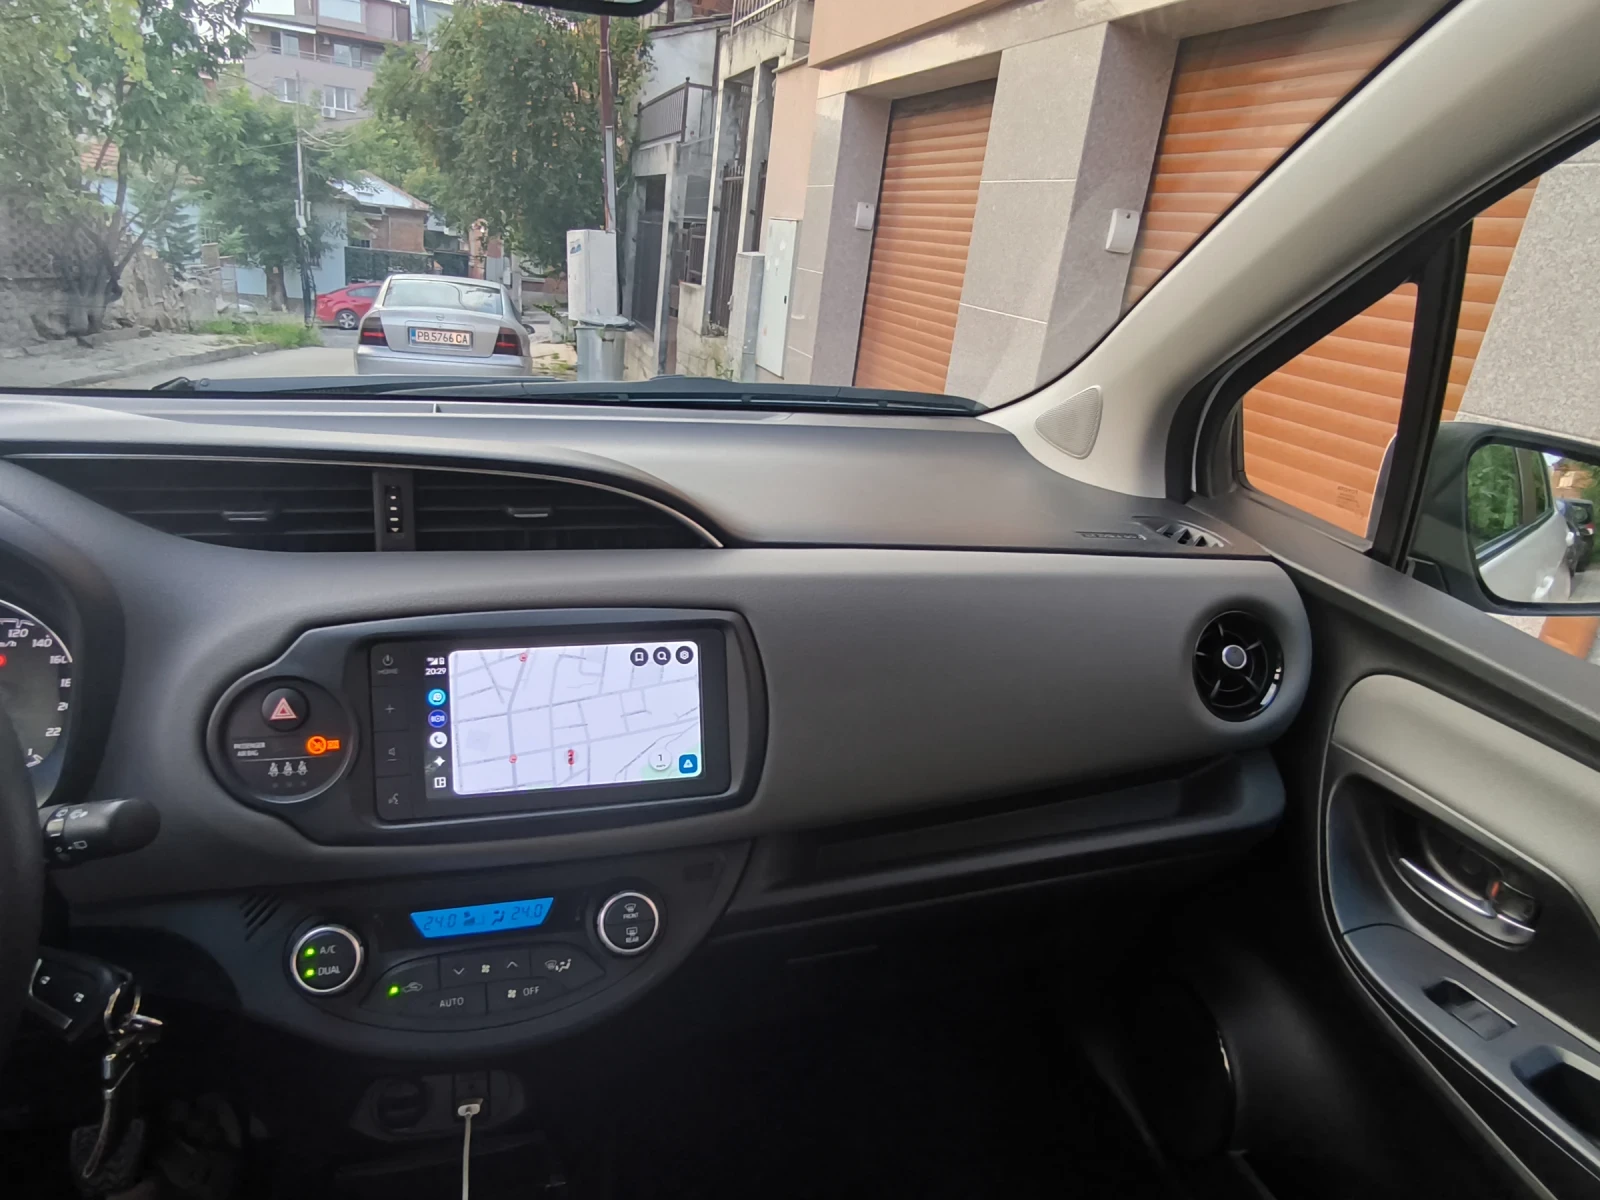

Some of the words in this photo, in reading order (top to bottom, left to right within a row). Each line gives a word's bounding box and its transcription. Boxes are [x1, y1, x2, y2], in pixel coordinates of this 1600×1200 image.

[8, 628, 29, 638] 120
[32, 638, 53, 648] 140
[511, 903, 543, 920] 24.0
[423, 913, 457, 931] 24.0
[320, 945, 336, 954] A/C
[318, 966, 341, 976] DUAL
[522, 986, 540, 996] OFF
[439, 997, 464, 1008] AUTO
